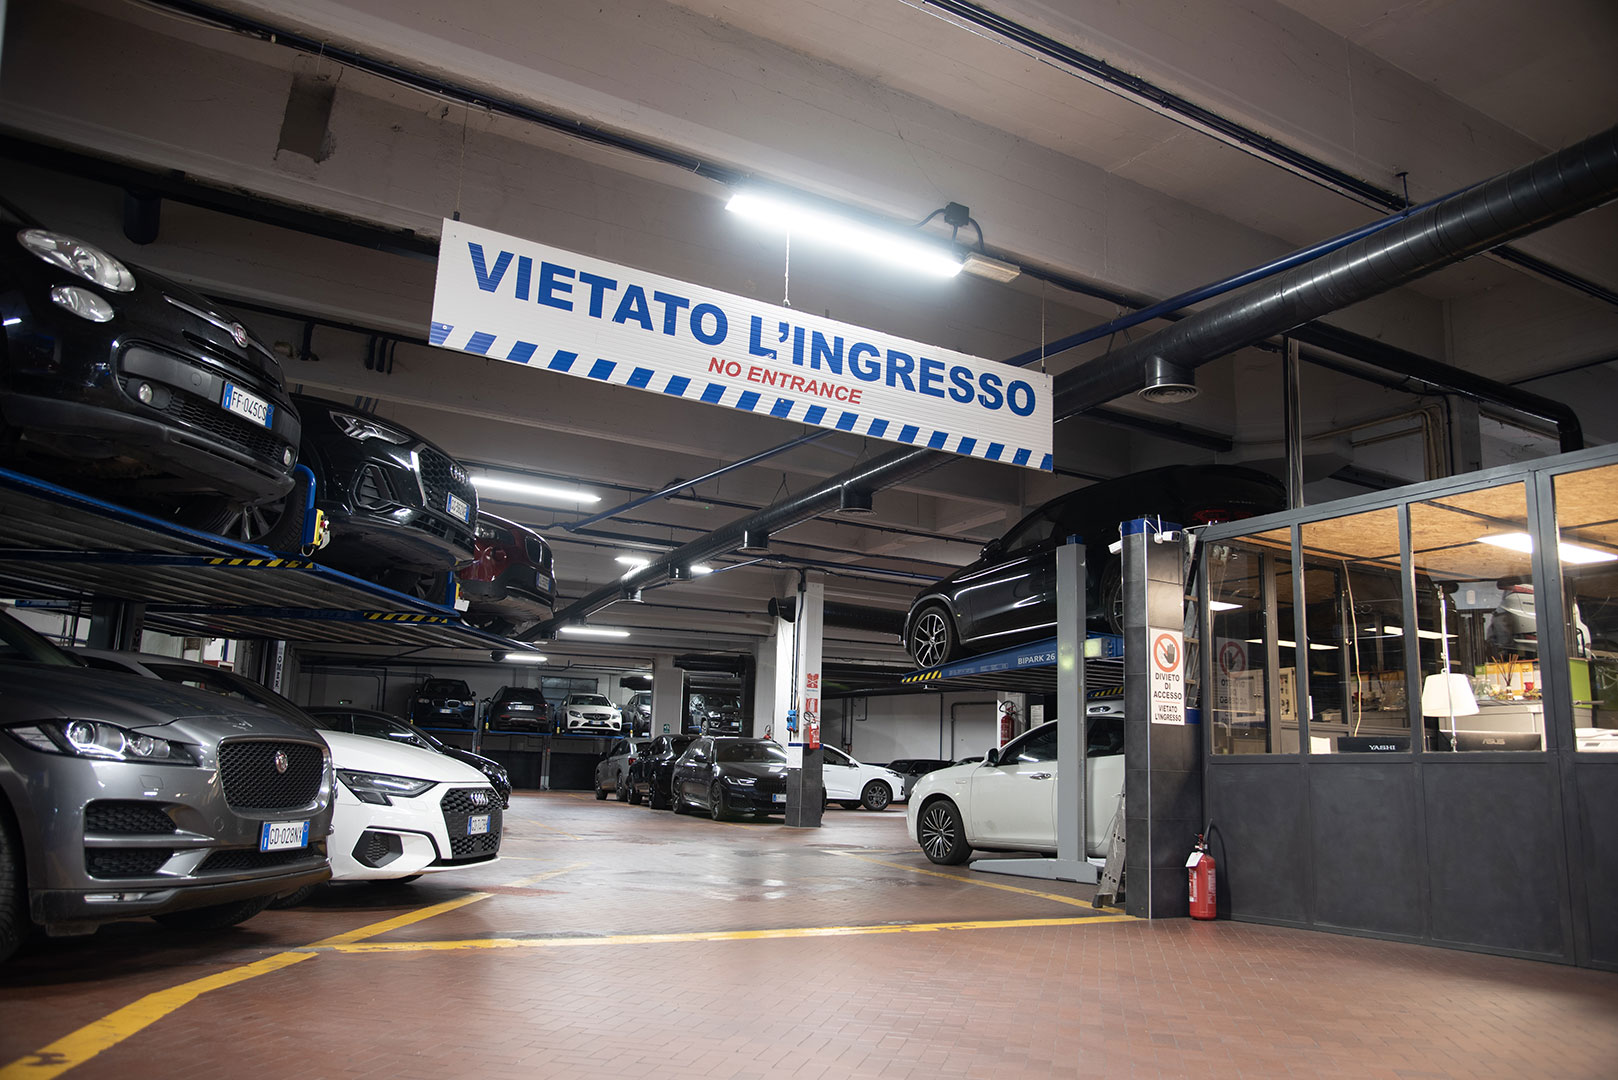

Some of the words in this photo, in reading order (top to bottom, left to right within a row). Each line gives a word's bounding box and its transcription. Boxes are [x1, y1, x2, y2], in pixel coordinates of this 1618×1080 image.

[467, 241, 729, 346] VIETATO
[748, 315, 1036, 417] L'INGRESSO
[708, 357, 742, 377] NO
[747, 366, 863, 404] ENTRANCE
[1017, 655, 1044, 665] BIPARK
[1046, 653, 1056, 661] 26
[1155, 672, 1180, 682] DIVIETO
[1164, 682, 1171, 690] DI
[1153, 691, 1182, 700] ACCESSO
[1158, 705, 1178, 713] VIETATO
